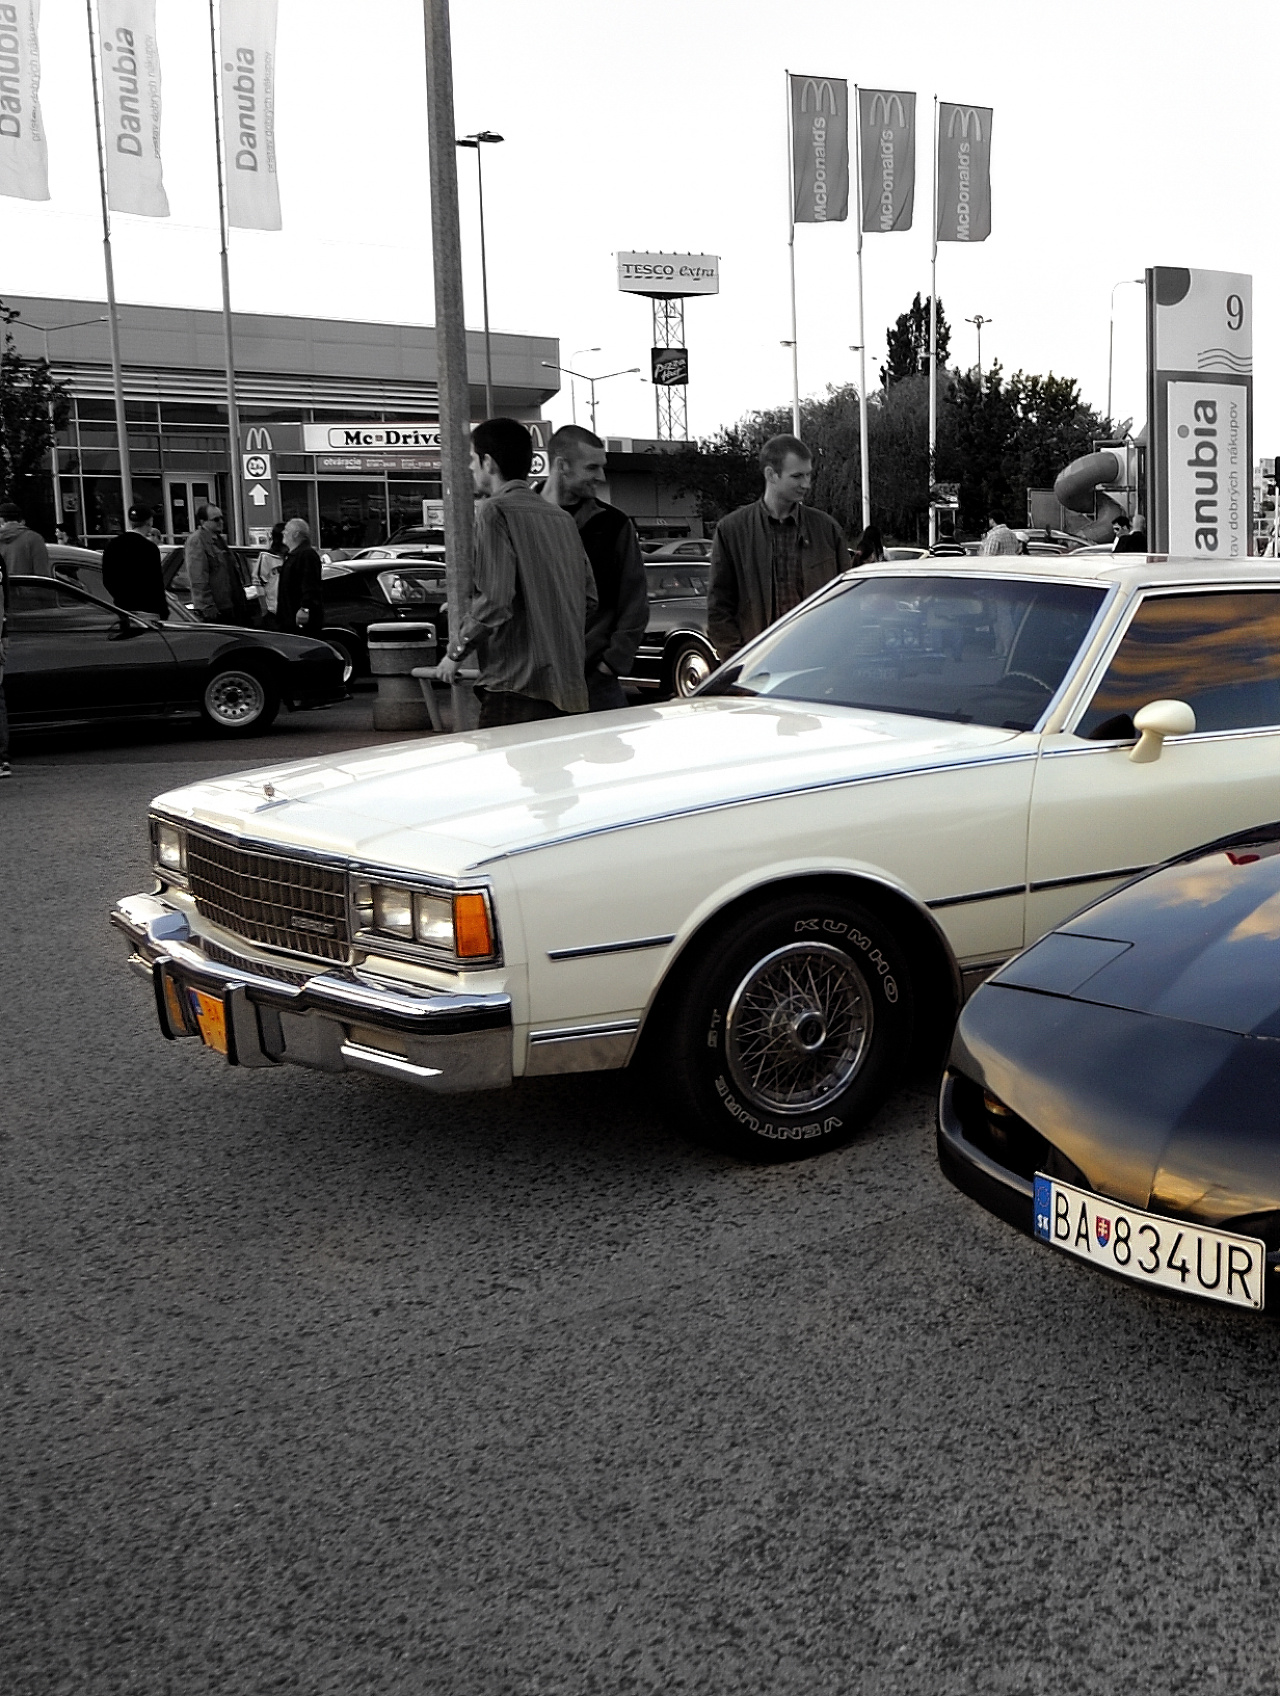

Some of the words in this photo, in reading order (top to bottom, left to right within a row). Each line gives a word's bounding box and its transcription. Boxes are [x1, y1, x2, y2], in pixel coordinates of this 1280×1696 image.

[103, 27, 142, 158] Danubia
[224, 47, 259, 173] Danubia
[812, 116, 827, 221] McDonald's
[880, 128, 894, 231] McDonald's
[956, 141, 970, 241] McDonald's
[622, 263, 675, 276] TESCO
[679, 265, 715, 277] extra
[1226, 294, 1244, 331] 9
[344, 430, 373, 446] Mc
[1228, 401, 1241, 465] nákupov
[1228, 470, 1241, 530] dobrých
[794, 918, 899, 1003] KUMHO
[714, 1074, 843, 1140] VENTURE
[1036, 1213, 1050, 1231] SK
